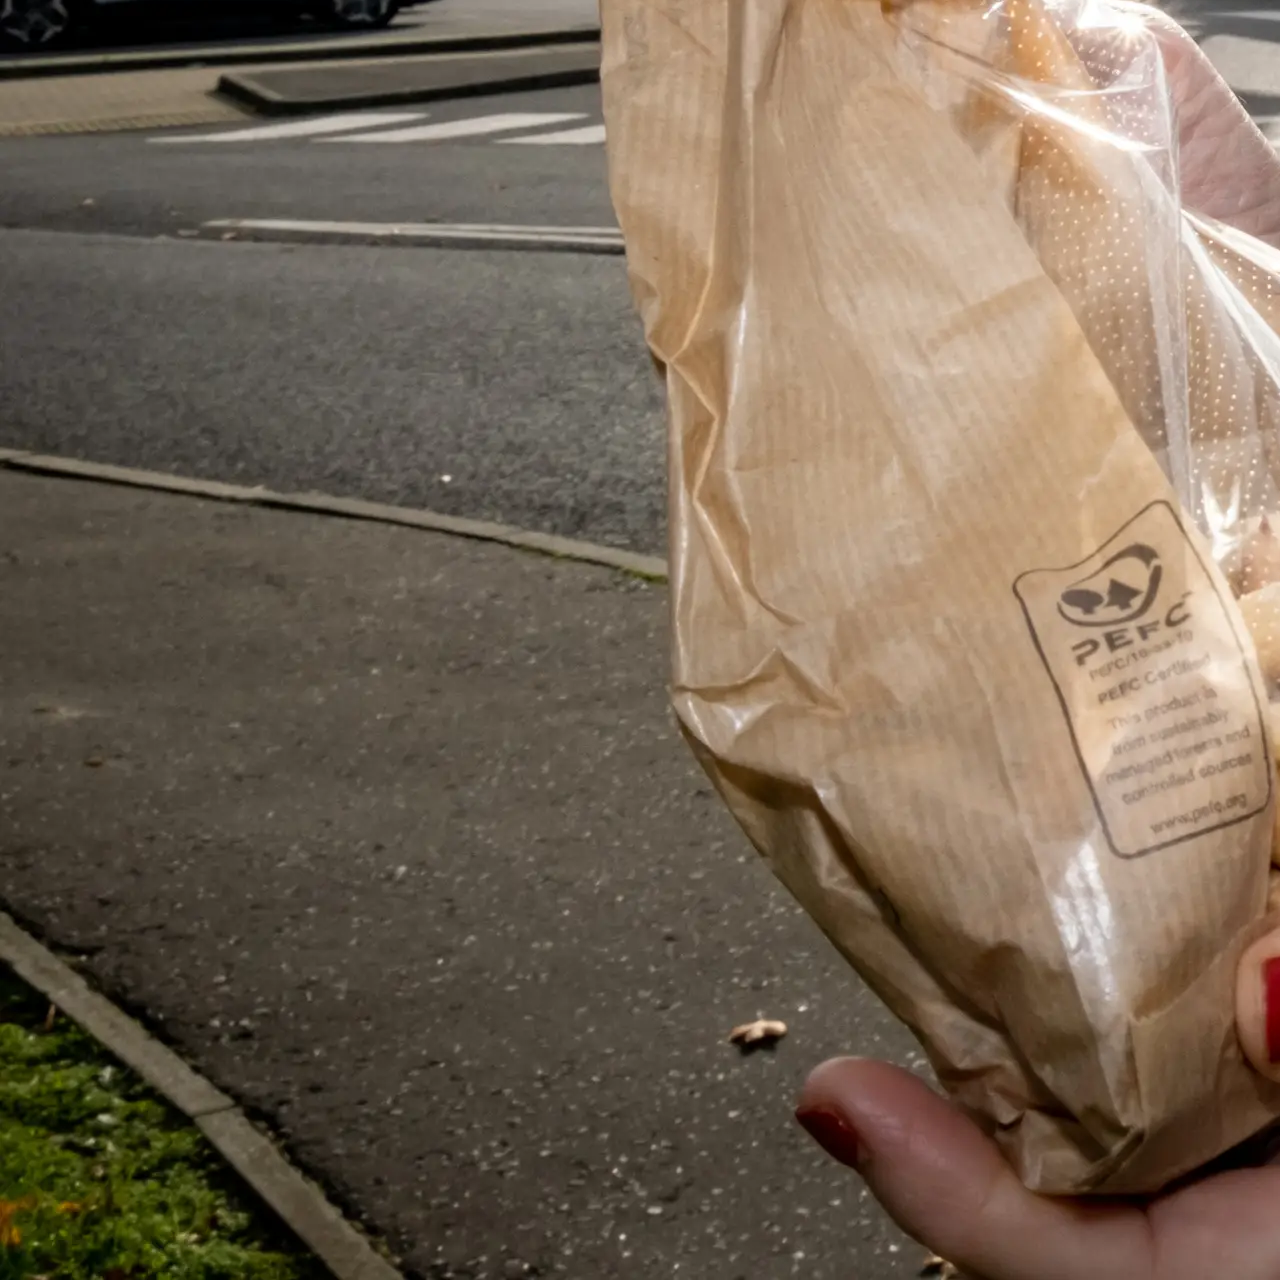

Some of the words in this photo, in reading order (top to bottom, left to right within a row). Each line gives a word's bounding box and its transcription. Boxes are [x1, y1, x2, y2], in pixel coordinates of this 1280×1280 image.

[1071, 601, 1191, 666] PEFC
[1098, 678, 1141, 705] PEFC
[1144, 693, 1200, 721] product
[1226, 725, 1250, 743] and
[1199, 753, 1252, 778] sources
